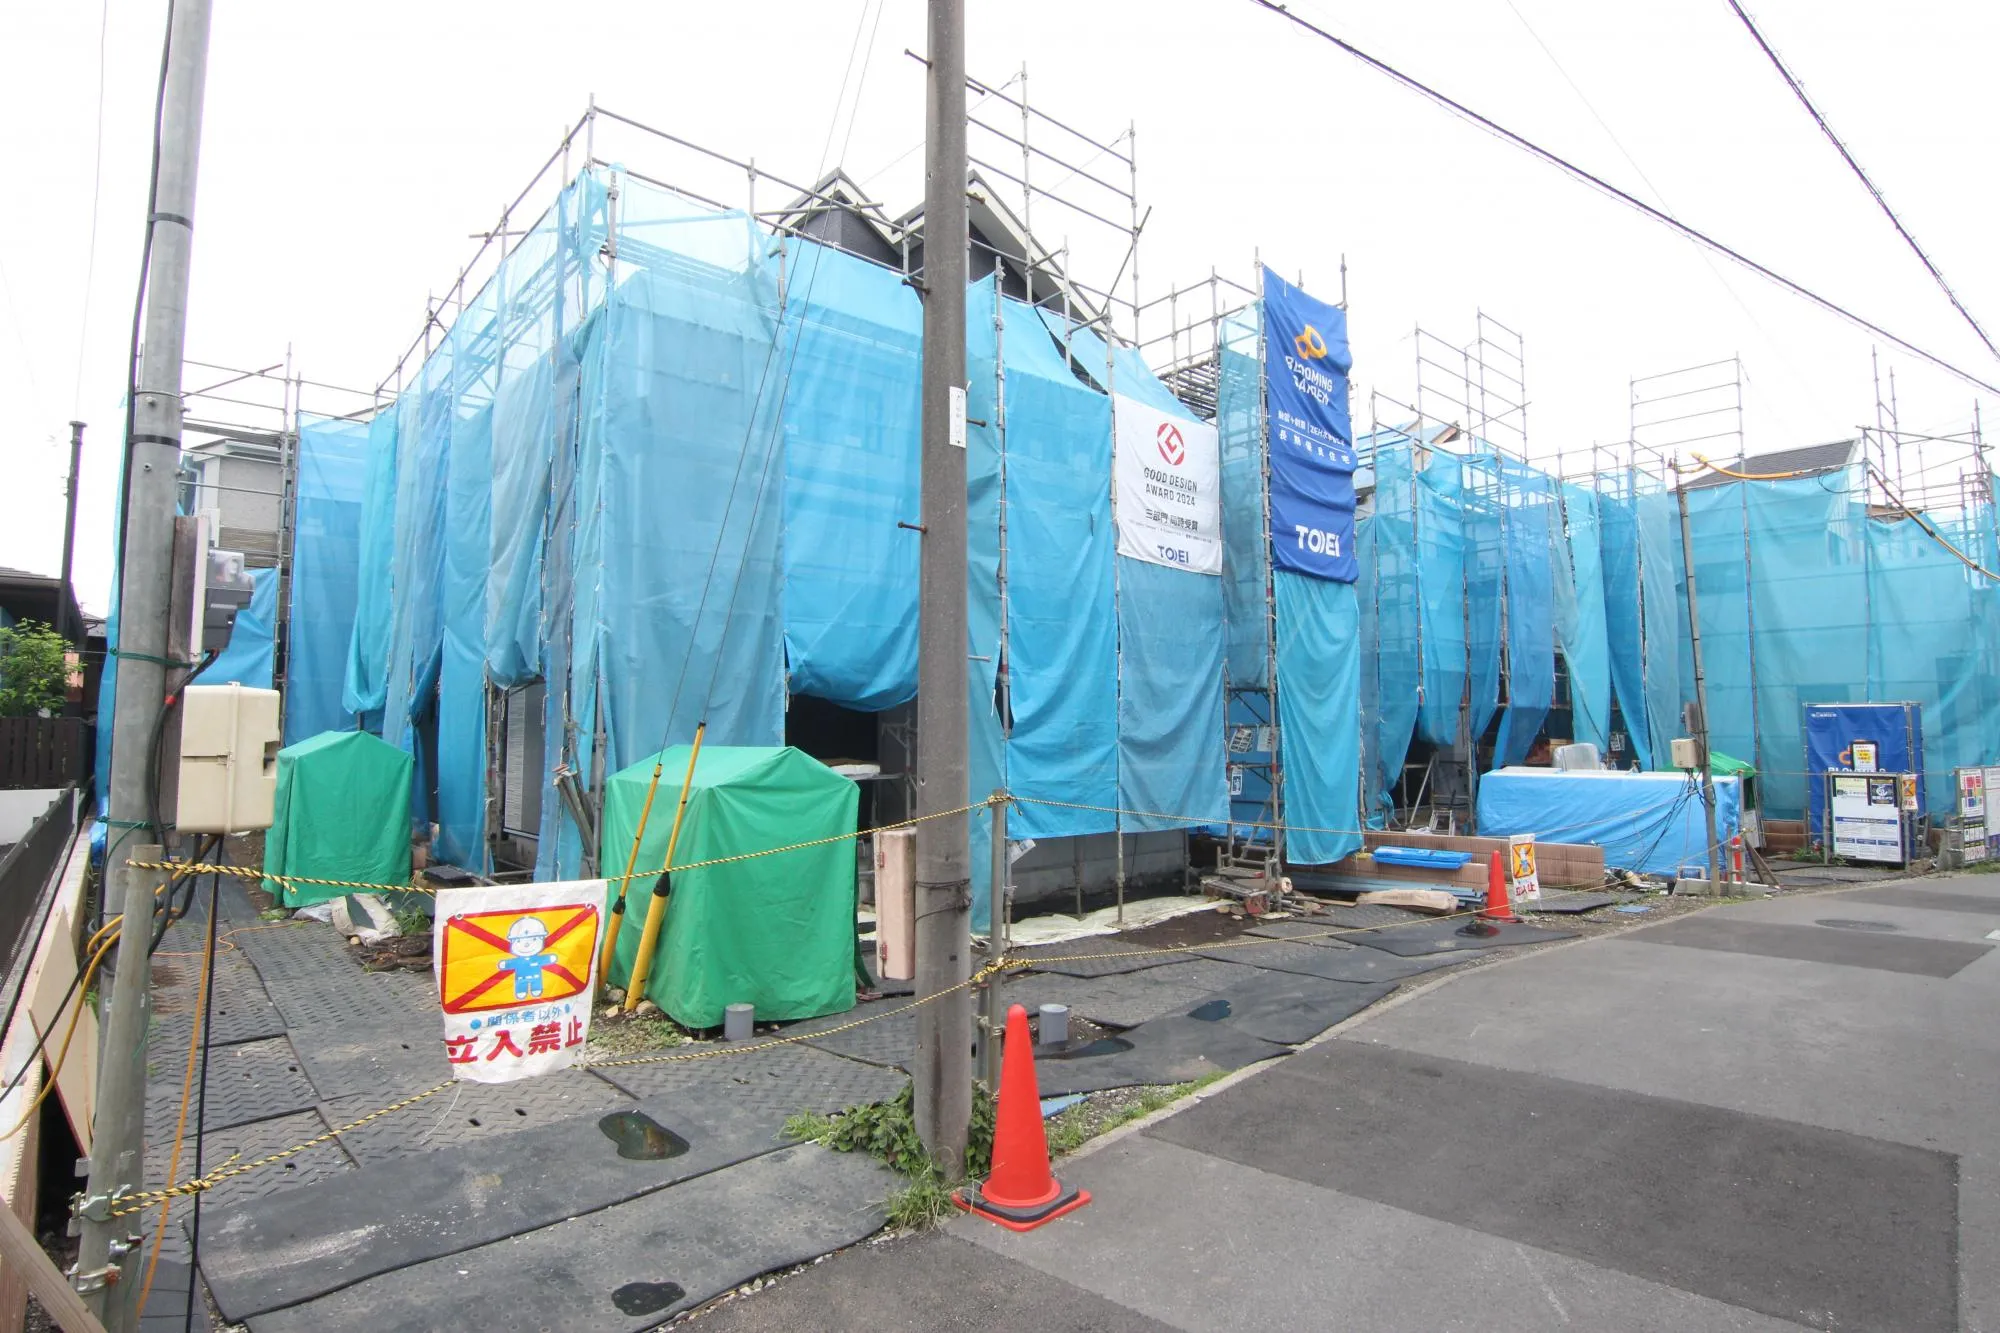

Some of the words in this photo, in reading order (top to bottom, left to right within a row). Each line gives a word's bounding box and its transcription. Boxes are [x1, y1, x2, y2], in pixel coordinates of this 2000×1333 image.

[1144, 467, 1167, 484] GOOD
[1169, 473, 1198, 492] DESIGN
[1145, 483, 1175, 501] AWARD
[1176, 493, 1196, 506] 2024
[1295, 525, 1340, 557] TOEI
[1157, 545, 1190, 564] TOEI
[487, 1005, 562, 1027] 関係者以外
[445, 1016, 583, 1064] 立入禁止
